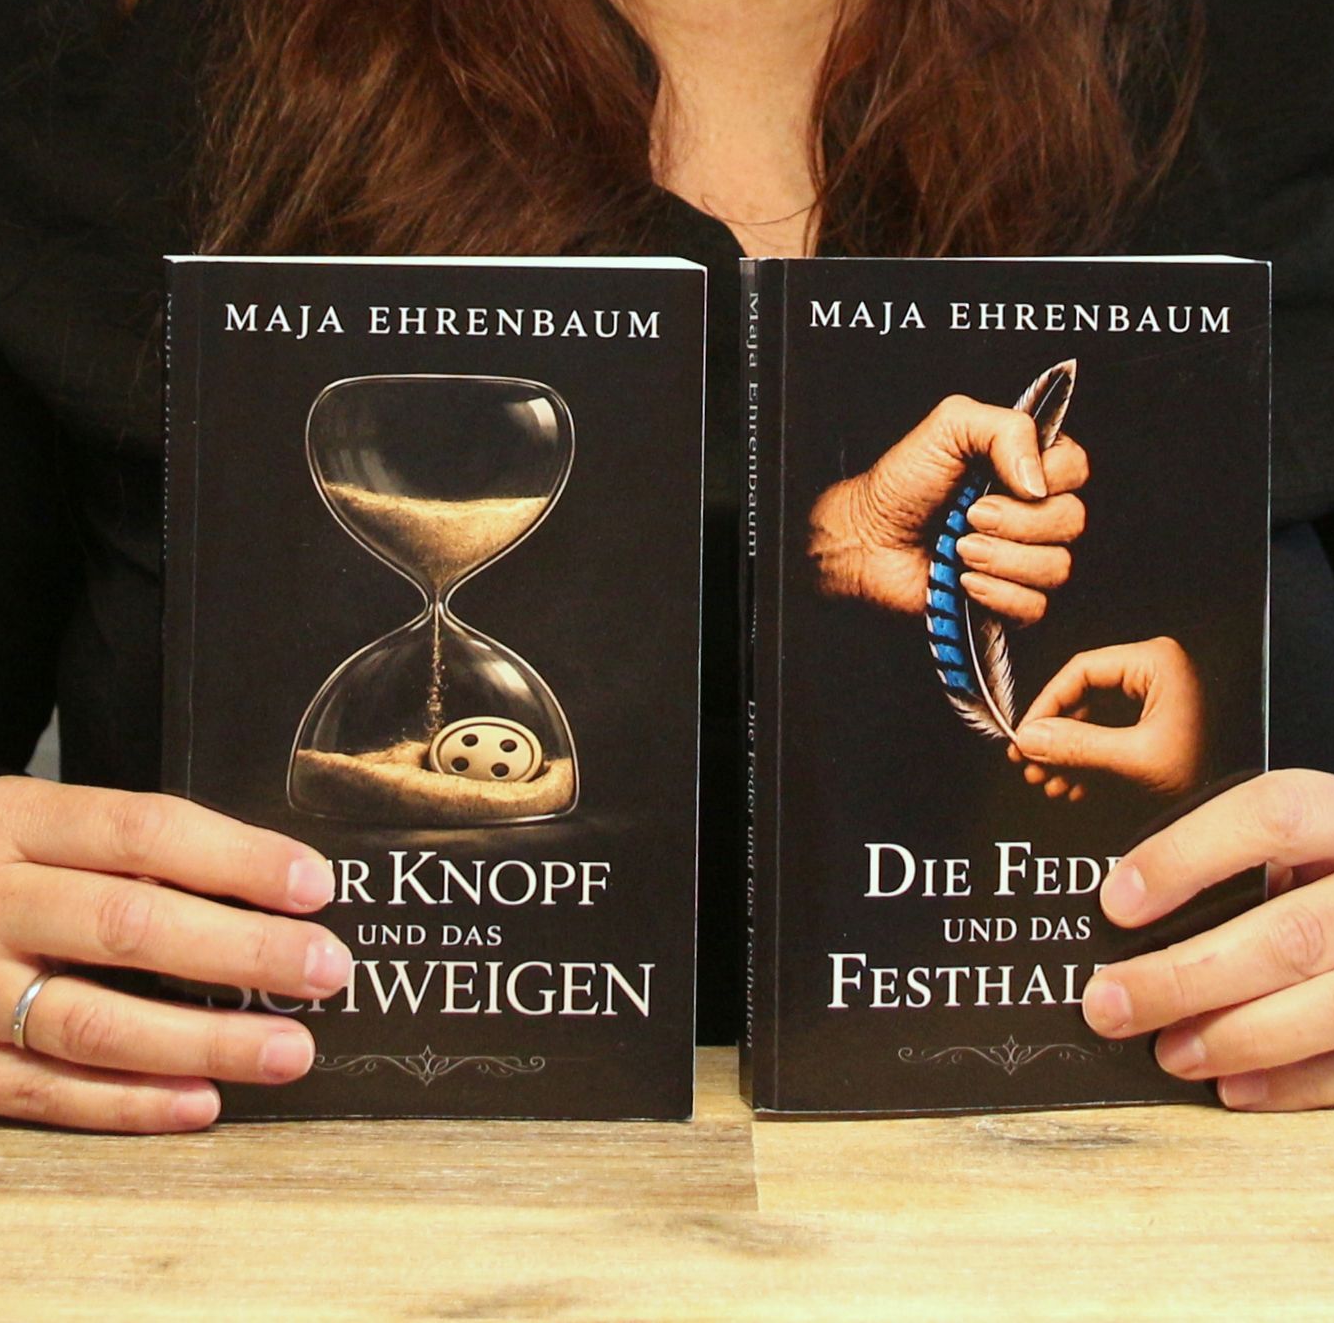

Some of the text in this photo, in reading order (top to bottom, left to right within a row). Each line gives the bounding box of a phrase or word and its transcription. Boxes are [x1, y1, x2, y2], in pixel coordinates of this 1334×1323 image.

[225, 304, 661, 340] MAJA EHRENBAUM
[810, 301, 1232, 336] MAJA EHRENBAUM
[746, 292, 759, 557] Maja Ehrenbaum
[387, 851, 612, 907] KNOPF
[864, 842, 973, 899] DIE
[357, 925, 503, 948] UND DAS
[943, 915, 1092, 944] UND DAS
[206, 960, 657, 1018] HWEIGEN
[827, 952, 1109, 1010] FESTHAL
